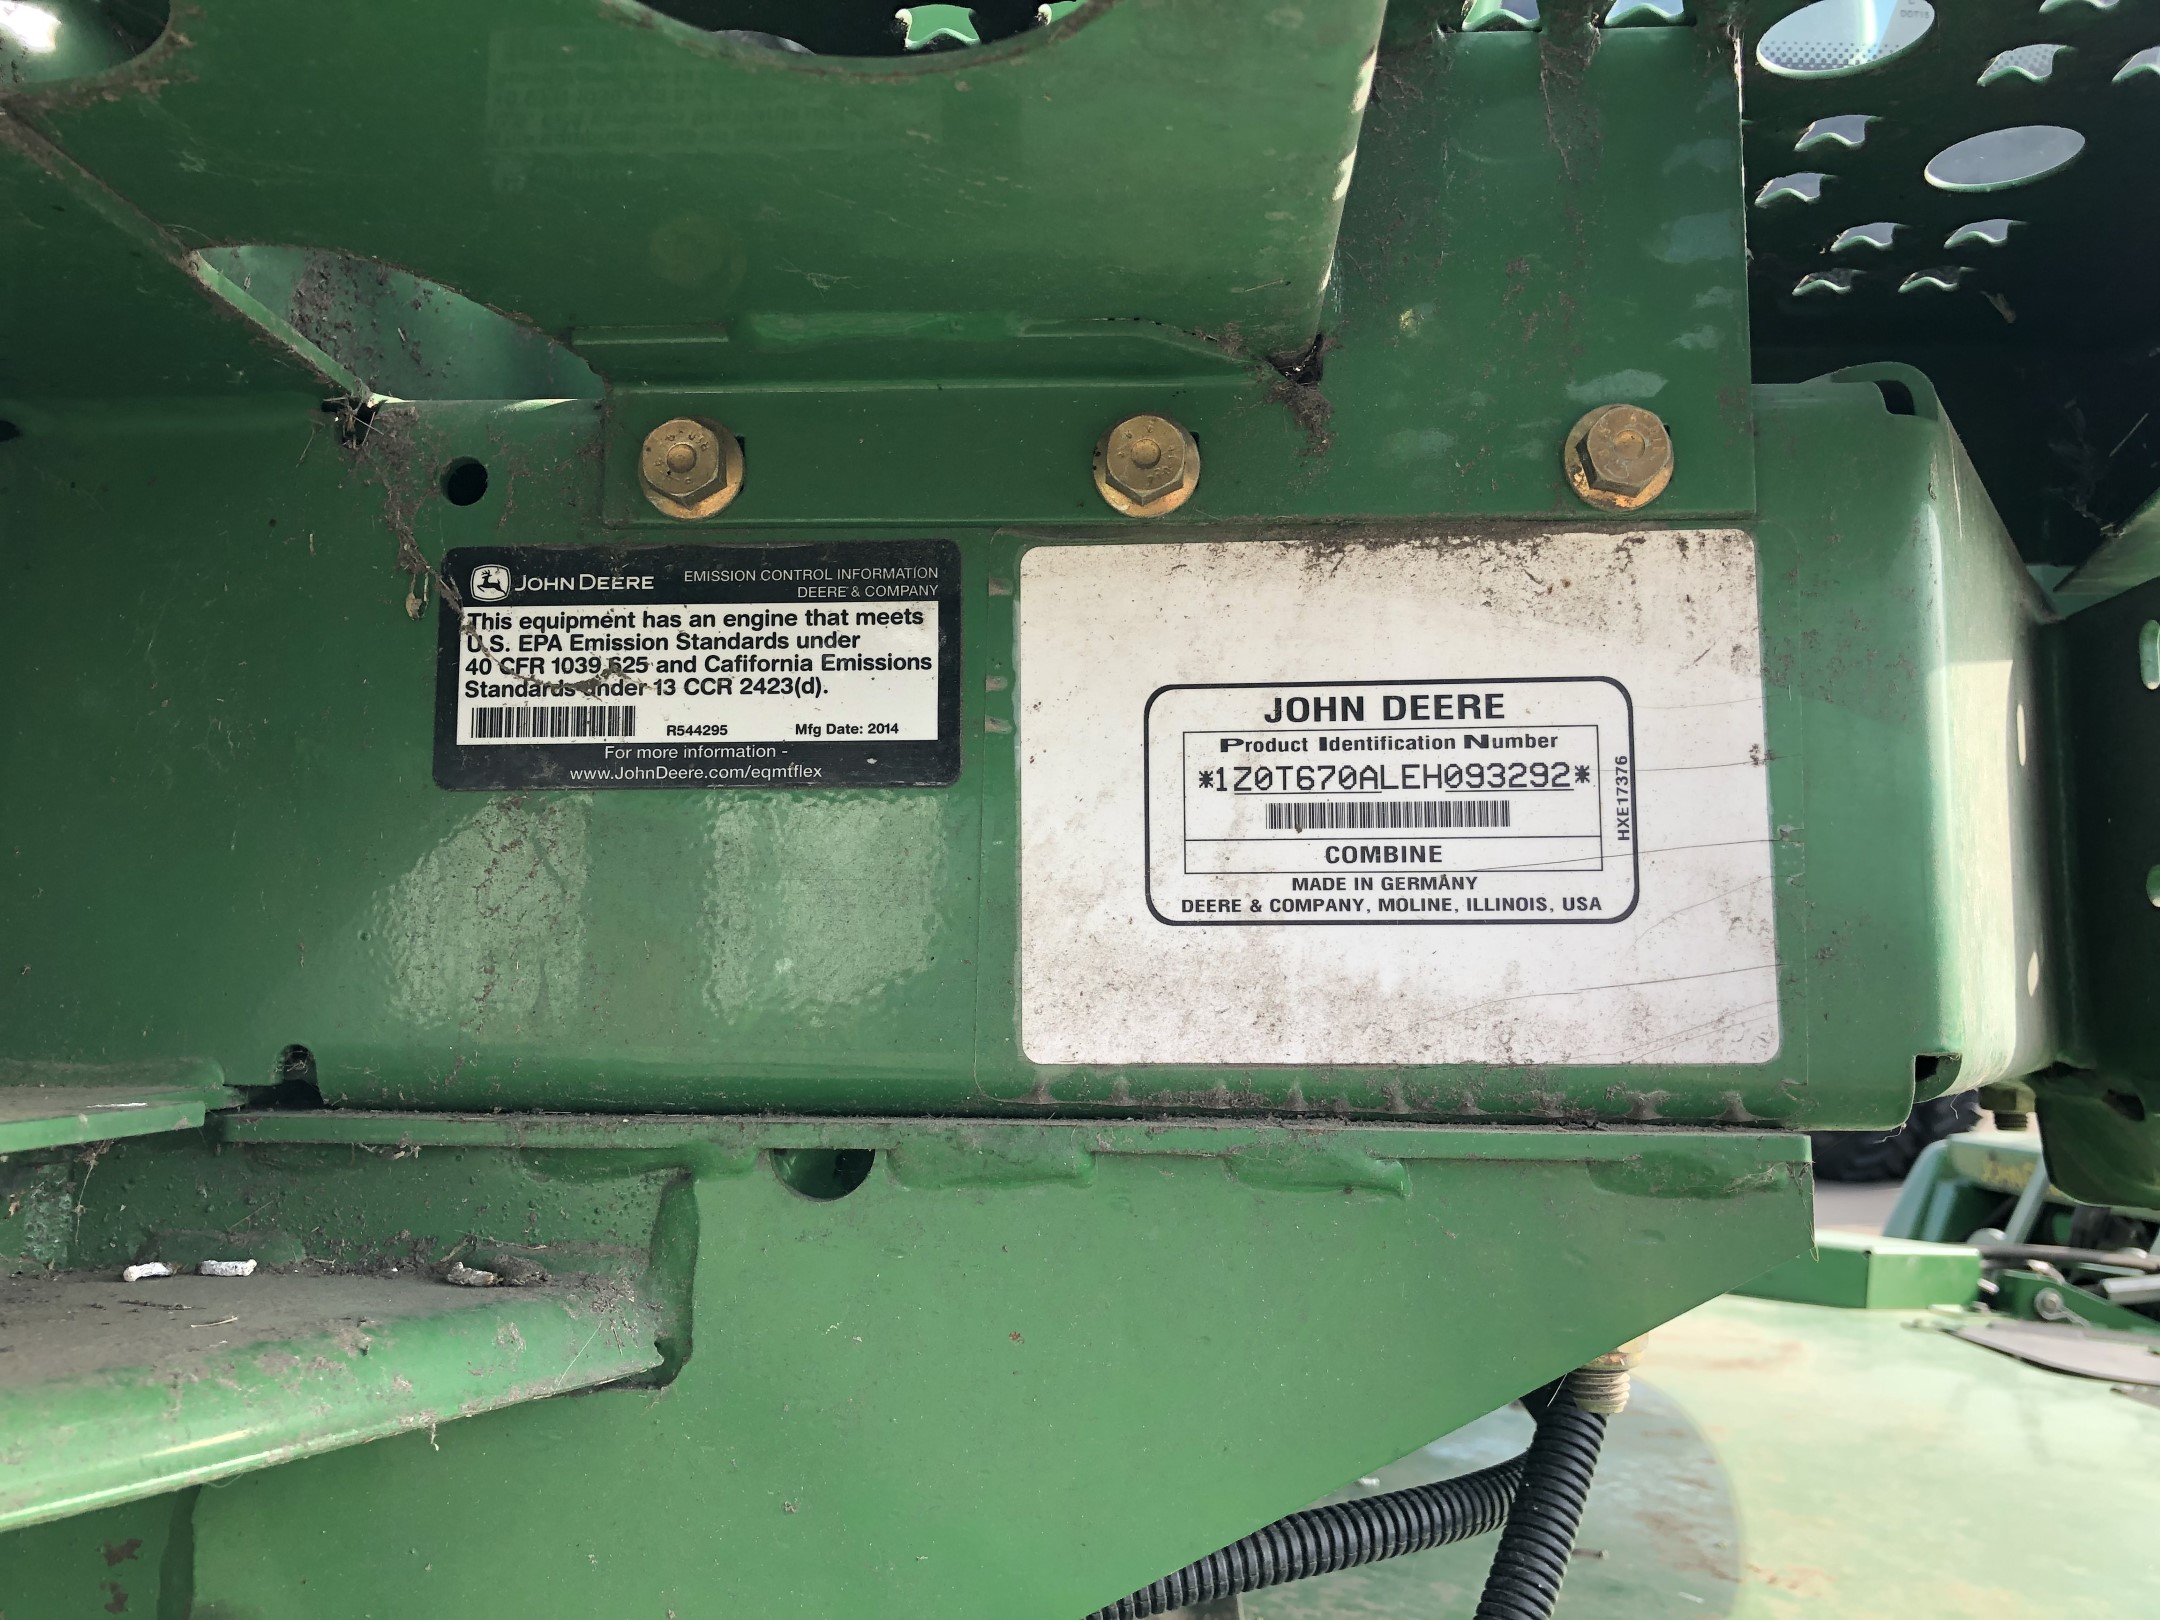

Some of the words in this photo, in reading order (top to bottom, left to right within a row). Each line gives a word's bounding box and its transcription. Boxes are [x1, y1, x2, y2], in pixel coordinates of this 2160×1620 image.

[515, 575, 574, 591] JOHN
[580, 574, 654, 590] DEERE
[685, 570, 755, 581] EMISSION
[760, 569, 832, 581] CONTROL
[838, 568, 937, 579] INFORMATION
[798, 587, 848, 597] DEERE
[851, 586, 860, 597] &
[865, 585, 938, 597] COMPANY
[466, 612, 512, 632] This
[521, 609, 635, 633] equipment
[643, 611, 681, 628] has
[688, 613, 716, 628] an
[724, 609, 797, 631] engine
[805, 609, 849, 626] that
[856, 609, 923, 625] meets
[466, 633, 510, 654] US.
[519, 632, 562, 651] EPA
[568, 634, 668, 651] Emission
[677, 631, 789, 650] Standards
[797, 631, 860, 649] under
[465, 656, 491, 675] 40
[498, 657, 544, 676] CFR
[552, 656, 649, 675] 1039625
[656, 655, 695, 673] and
[822, 653, 932, 671] Emissions
[465, 677, 576, 698] Standards
[654, 679, 676, 695] 13
[684, 678, 734, 695] CCR
[740, 677, 828, 698] 2423(d).
[1265, 696, 1363, 723] JOHN
[1383, 694, 1504, 720] DEERE
[667, 725, 727, 736] R544295
[796, 724, 821, 737] Mfg
[827, 724, 862, 734] Date:
[868, 723, 899, 734] 2014
[605, 746, 628, 758] For
[630, 749, 678, 758] more
[684, 745, 775, 758] information
[1221, 738, 1308, 752] Product
[1319, 736, 1455, 751] Identification
[1464, 734, 1558, 748] Number
[570, 763, 821, 783] www.JohnDeere.com/eqmtflex
[1615, 756, 1629, 840] HXE17376
[1326, 846, 1442, 863] COMBINE
[1293, 878, 1346, 890] MADE
[1355, 878, 1372, 890] IN
[1381, 876, 1477, 890] GERMANY
[1182, 899, 1241, 912] DEERE
[1250, 899, 1261, 912] &
[1270, 899, 1370, 914] COMPANY,
[1379, 898, 1458, 914] MOLINE,
[1467, 897, 1553, 913] ILLINOIS,
[1563, 897, 1601, 911] USA
